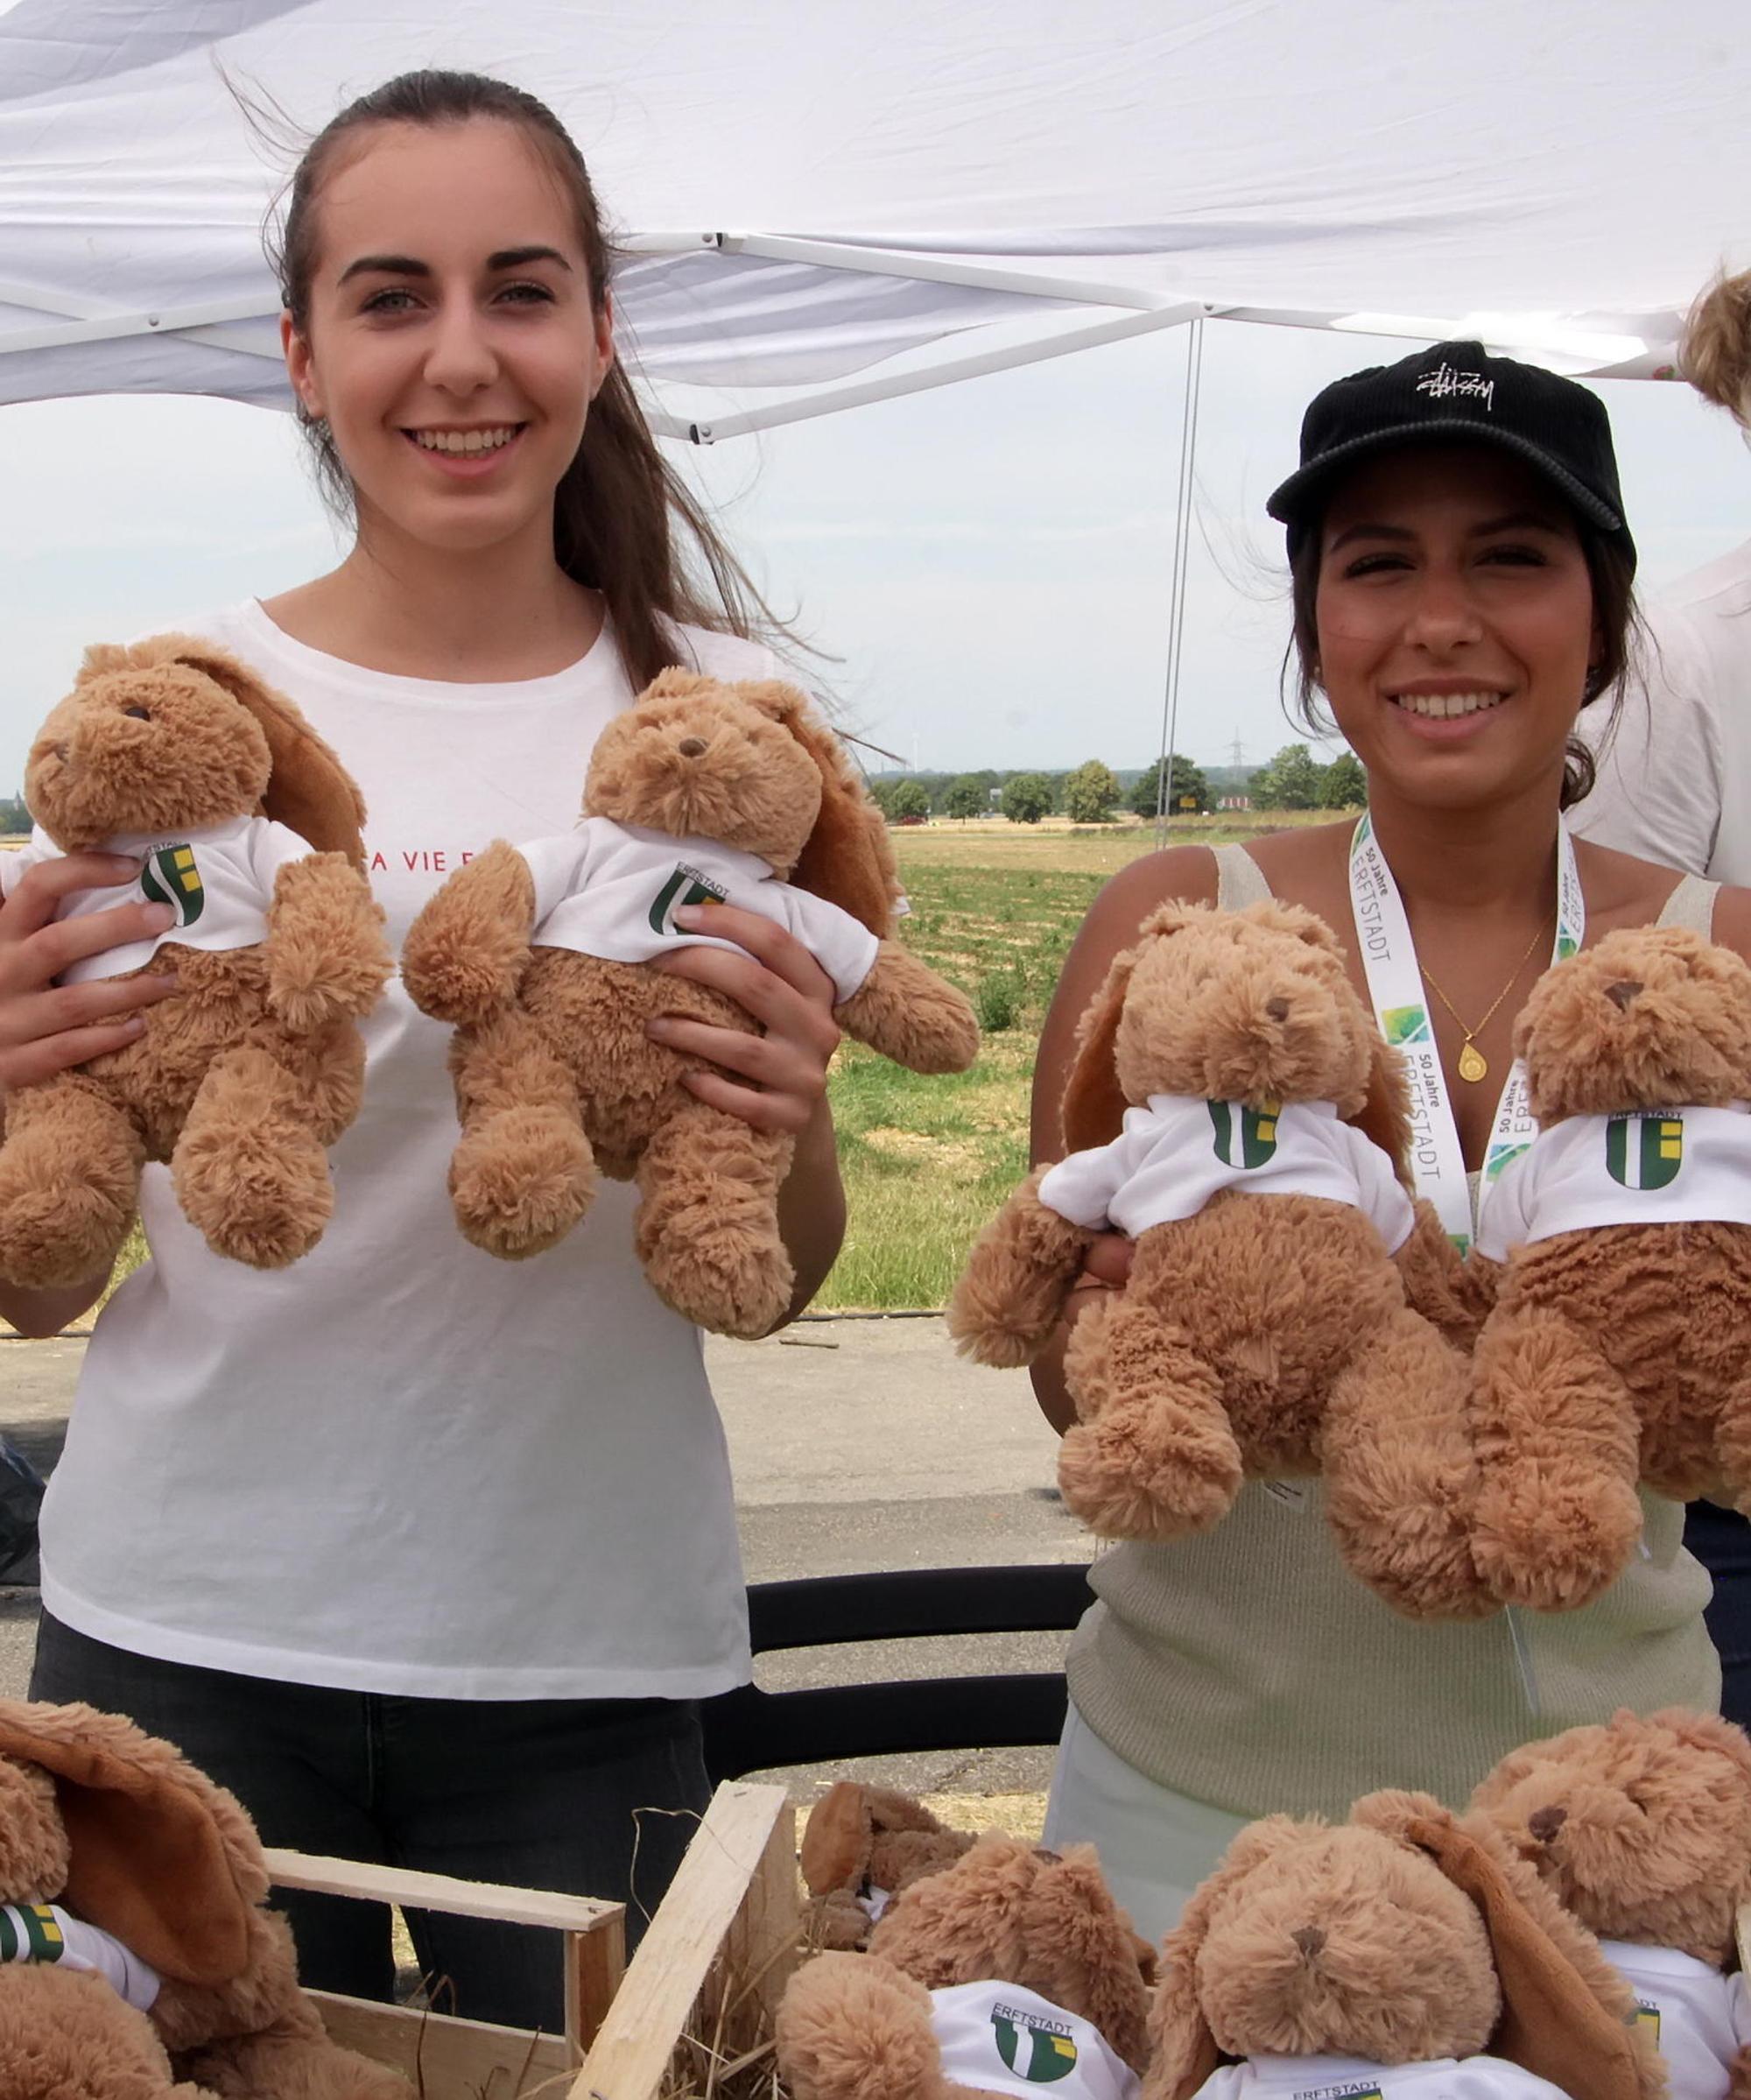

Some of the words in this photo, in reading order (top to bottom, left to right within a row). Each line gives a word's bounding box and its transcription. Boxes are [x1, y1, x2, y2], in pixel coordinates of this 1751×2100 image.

[403, 851, 447, 872] VIE
[1366, 847, 1376, 863] 50
[1371, 863, 1389, 897] Jahre
[1352, 856, 1391, 962] ERFTSTADT
[1419, 1054, 1432, 1069] 50
[1423, 1073, 1440, 1108] Jahre
[1503, 1079, 1519, 1115] Jahre
[1499, 1118, 1511, 1133] 50
[993, 2002, 1073, 2036] ERFTSTADT
[1293, 2081, 1380, 2100] ERFTSTADT
